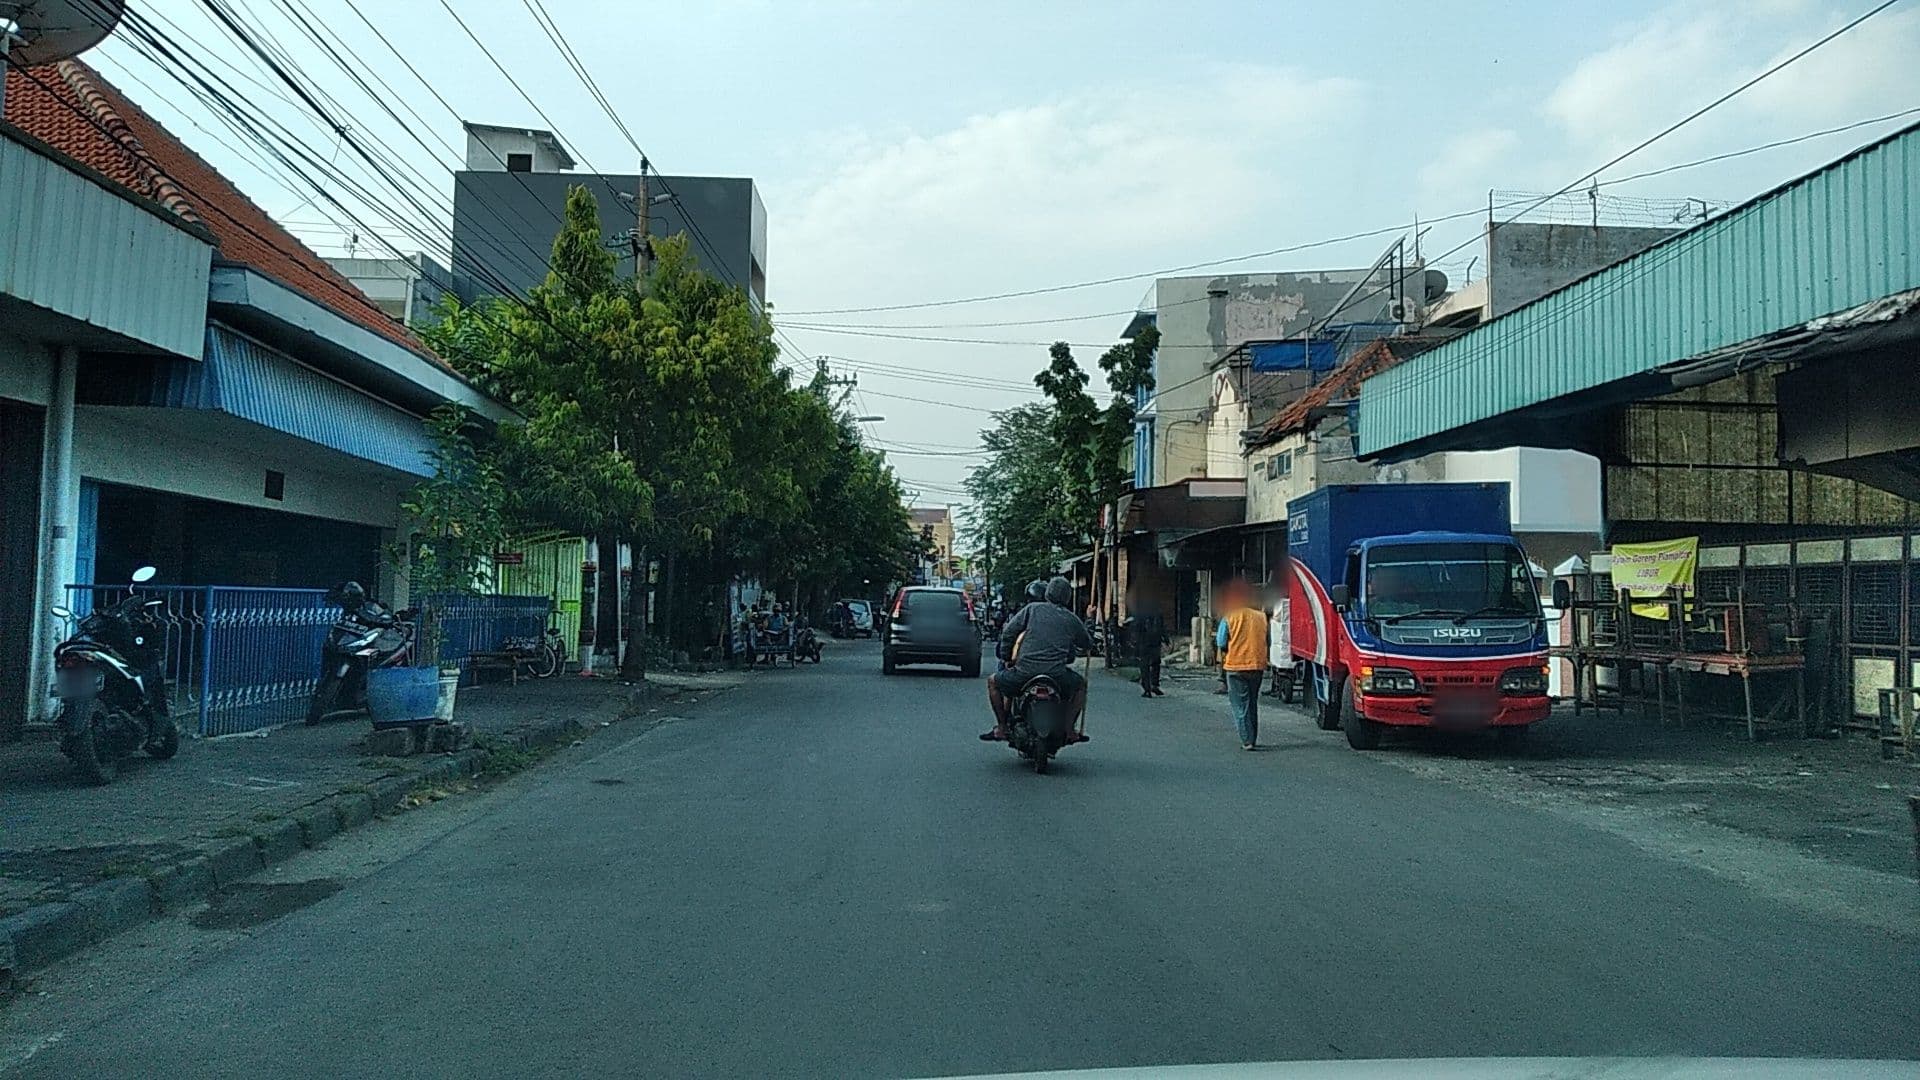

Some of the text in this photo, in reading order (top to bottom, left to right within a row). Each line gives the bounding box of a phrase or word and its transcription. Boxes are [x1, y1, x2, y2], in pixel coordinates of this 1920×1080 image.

[1632, 554, 1657, 564] Goreng
[1637, 568, 1659, 577] LIBUR
[1433, 628, 1481, 637] ISUZU
